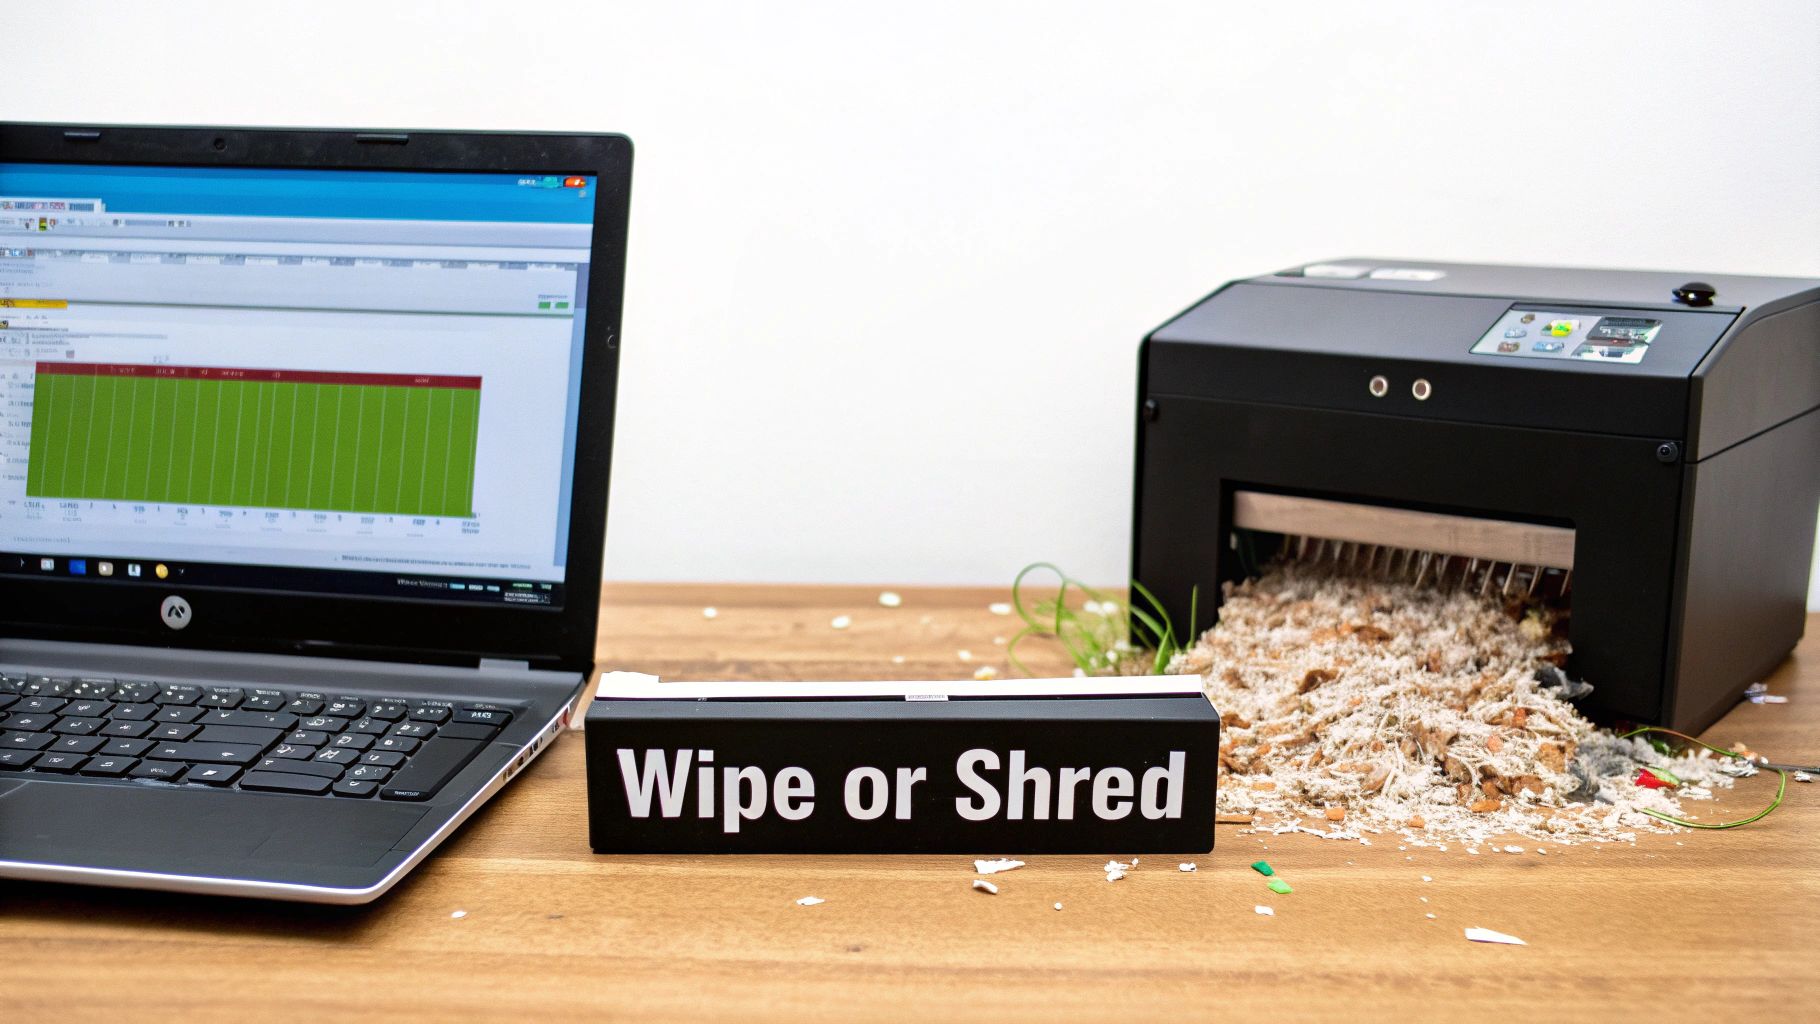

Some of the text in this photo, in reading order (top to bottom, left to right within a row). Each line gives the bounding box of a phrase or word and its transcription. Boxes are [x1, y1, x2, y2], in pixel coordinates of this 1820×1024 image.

[616, 748, 1186, 833] Wipe or Shred
